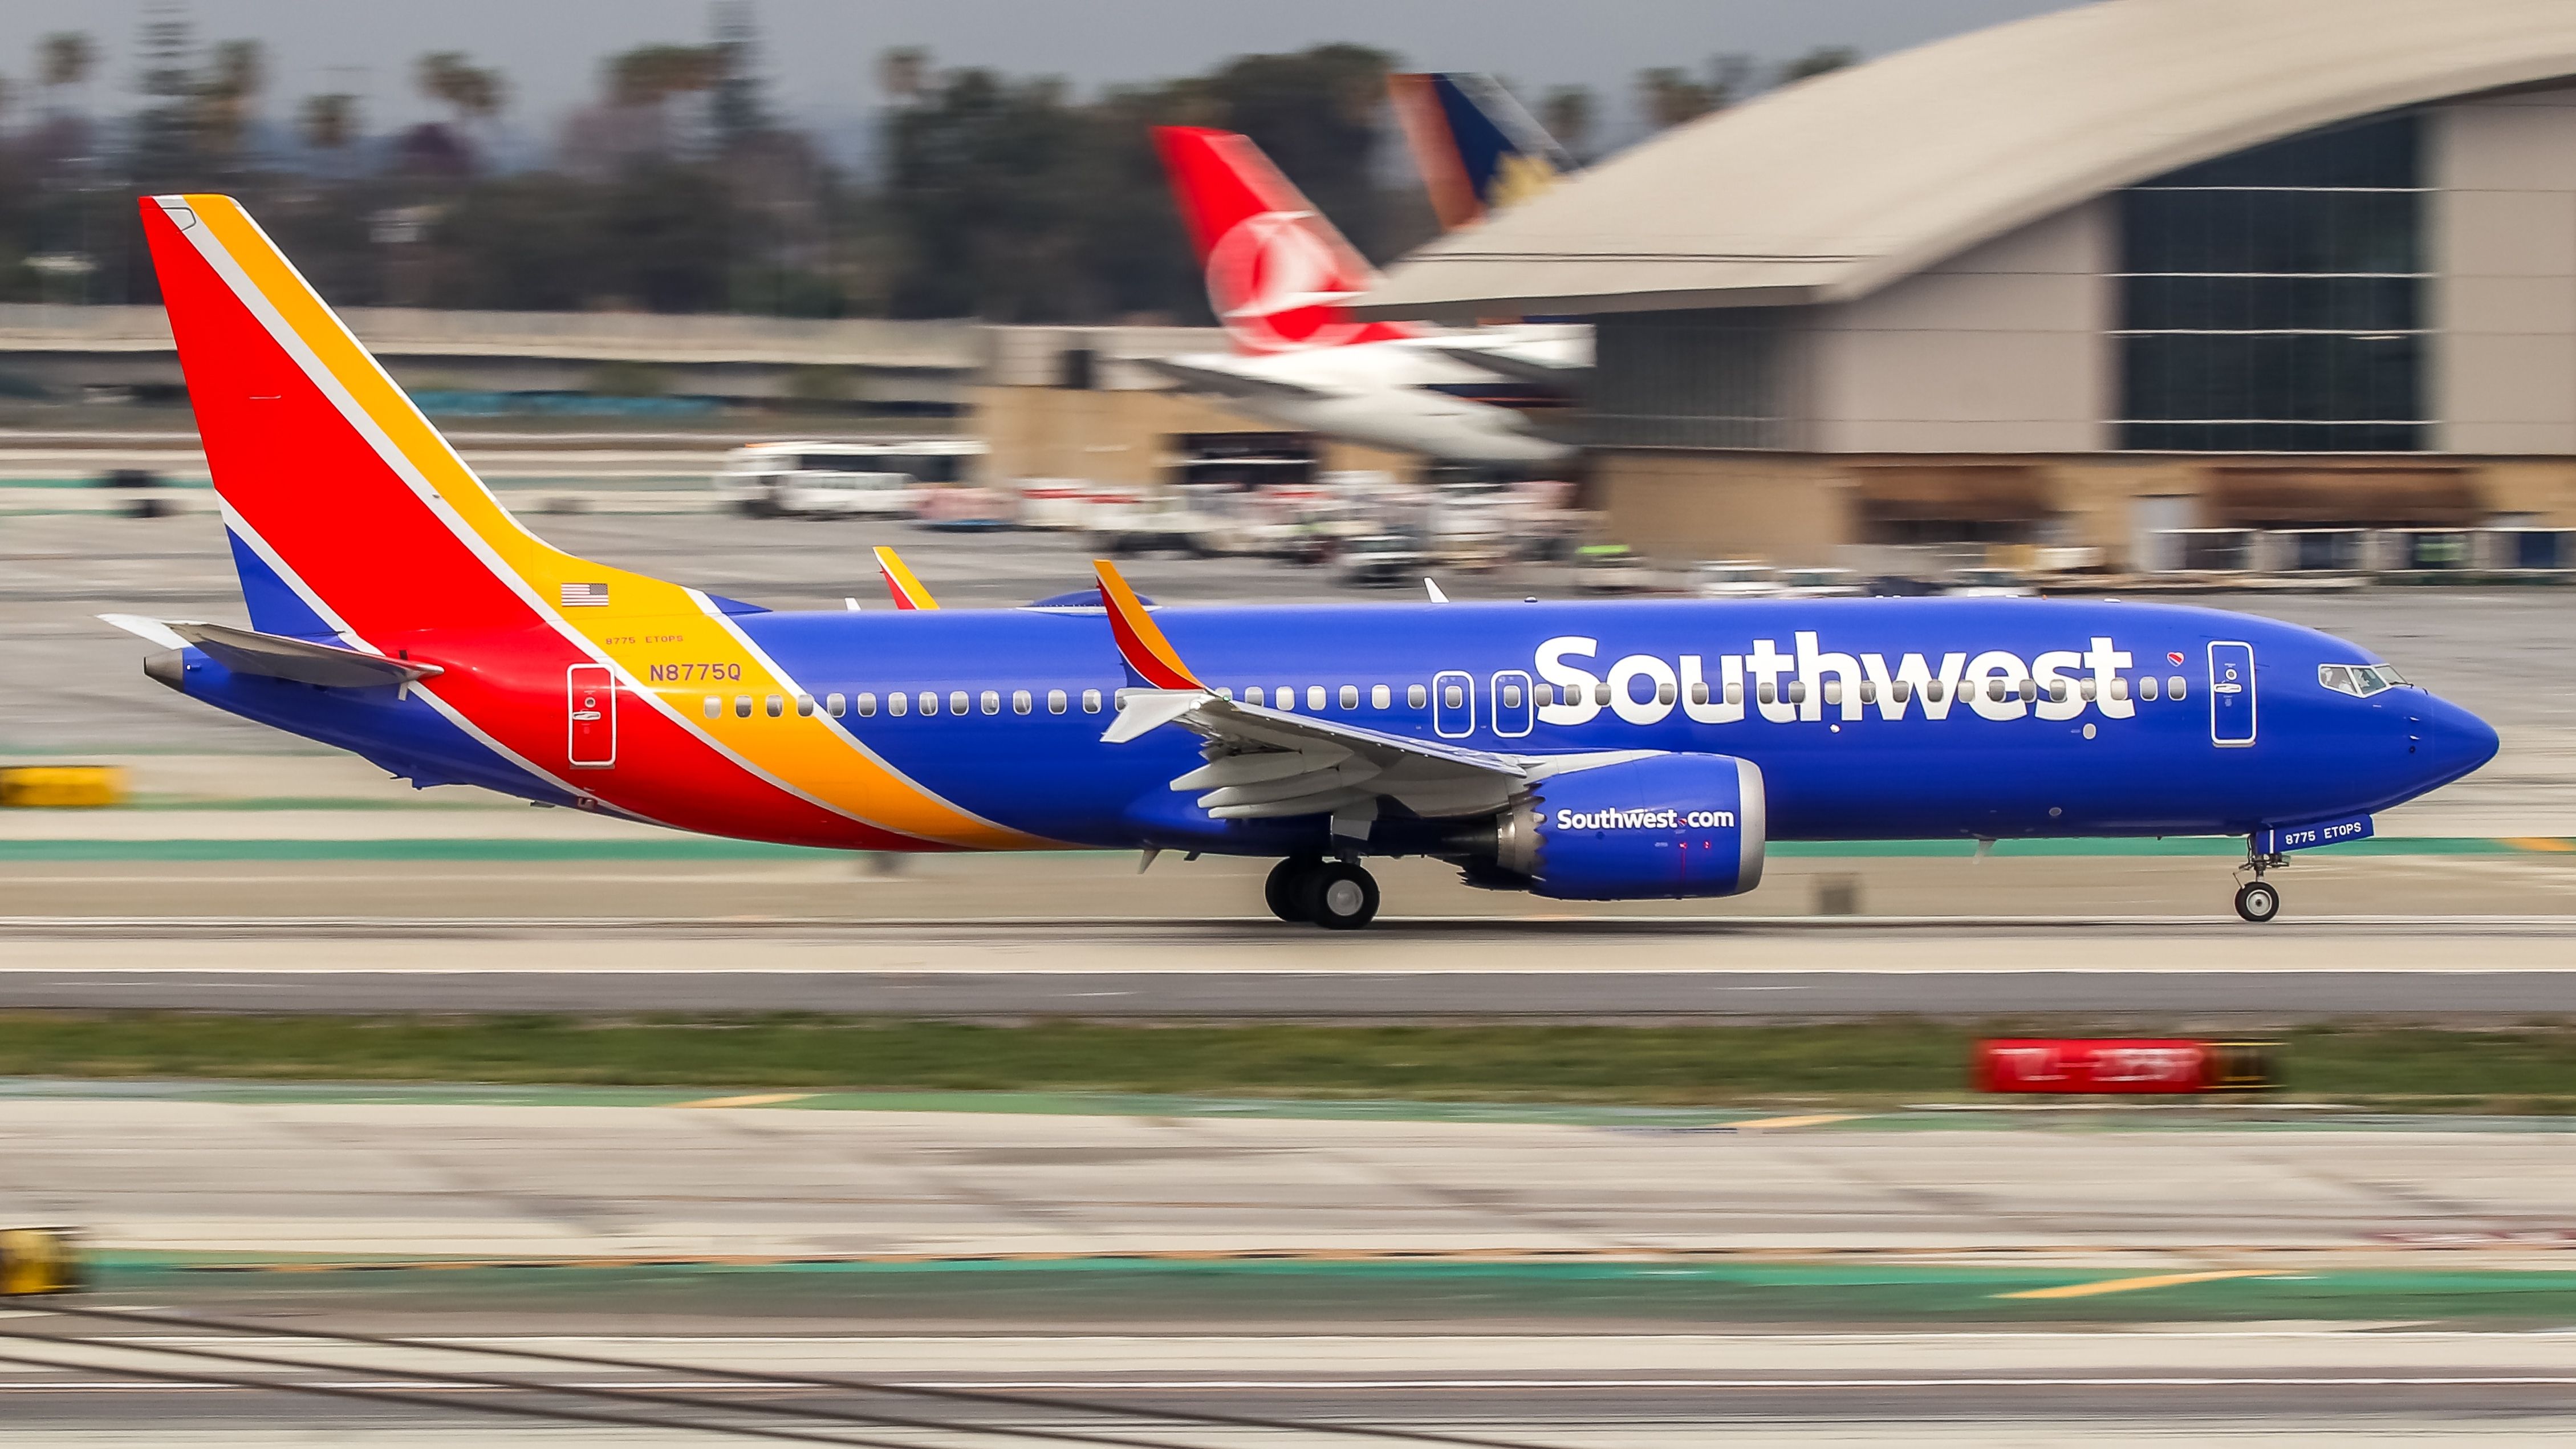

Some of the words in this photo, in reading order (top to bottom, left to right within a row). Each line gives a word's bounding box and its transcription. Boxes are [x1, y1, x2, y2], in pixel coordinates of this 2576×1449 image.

[650, 663, 741, 681] N8775Q
[1534, 631, 2136, 725] Southwest
[2285, 830, 2316, 845] 8775
[2323, 822, 2362, 839] ETOPS
